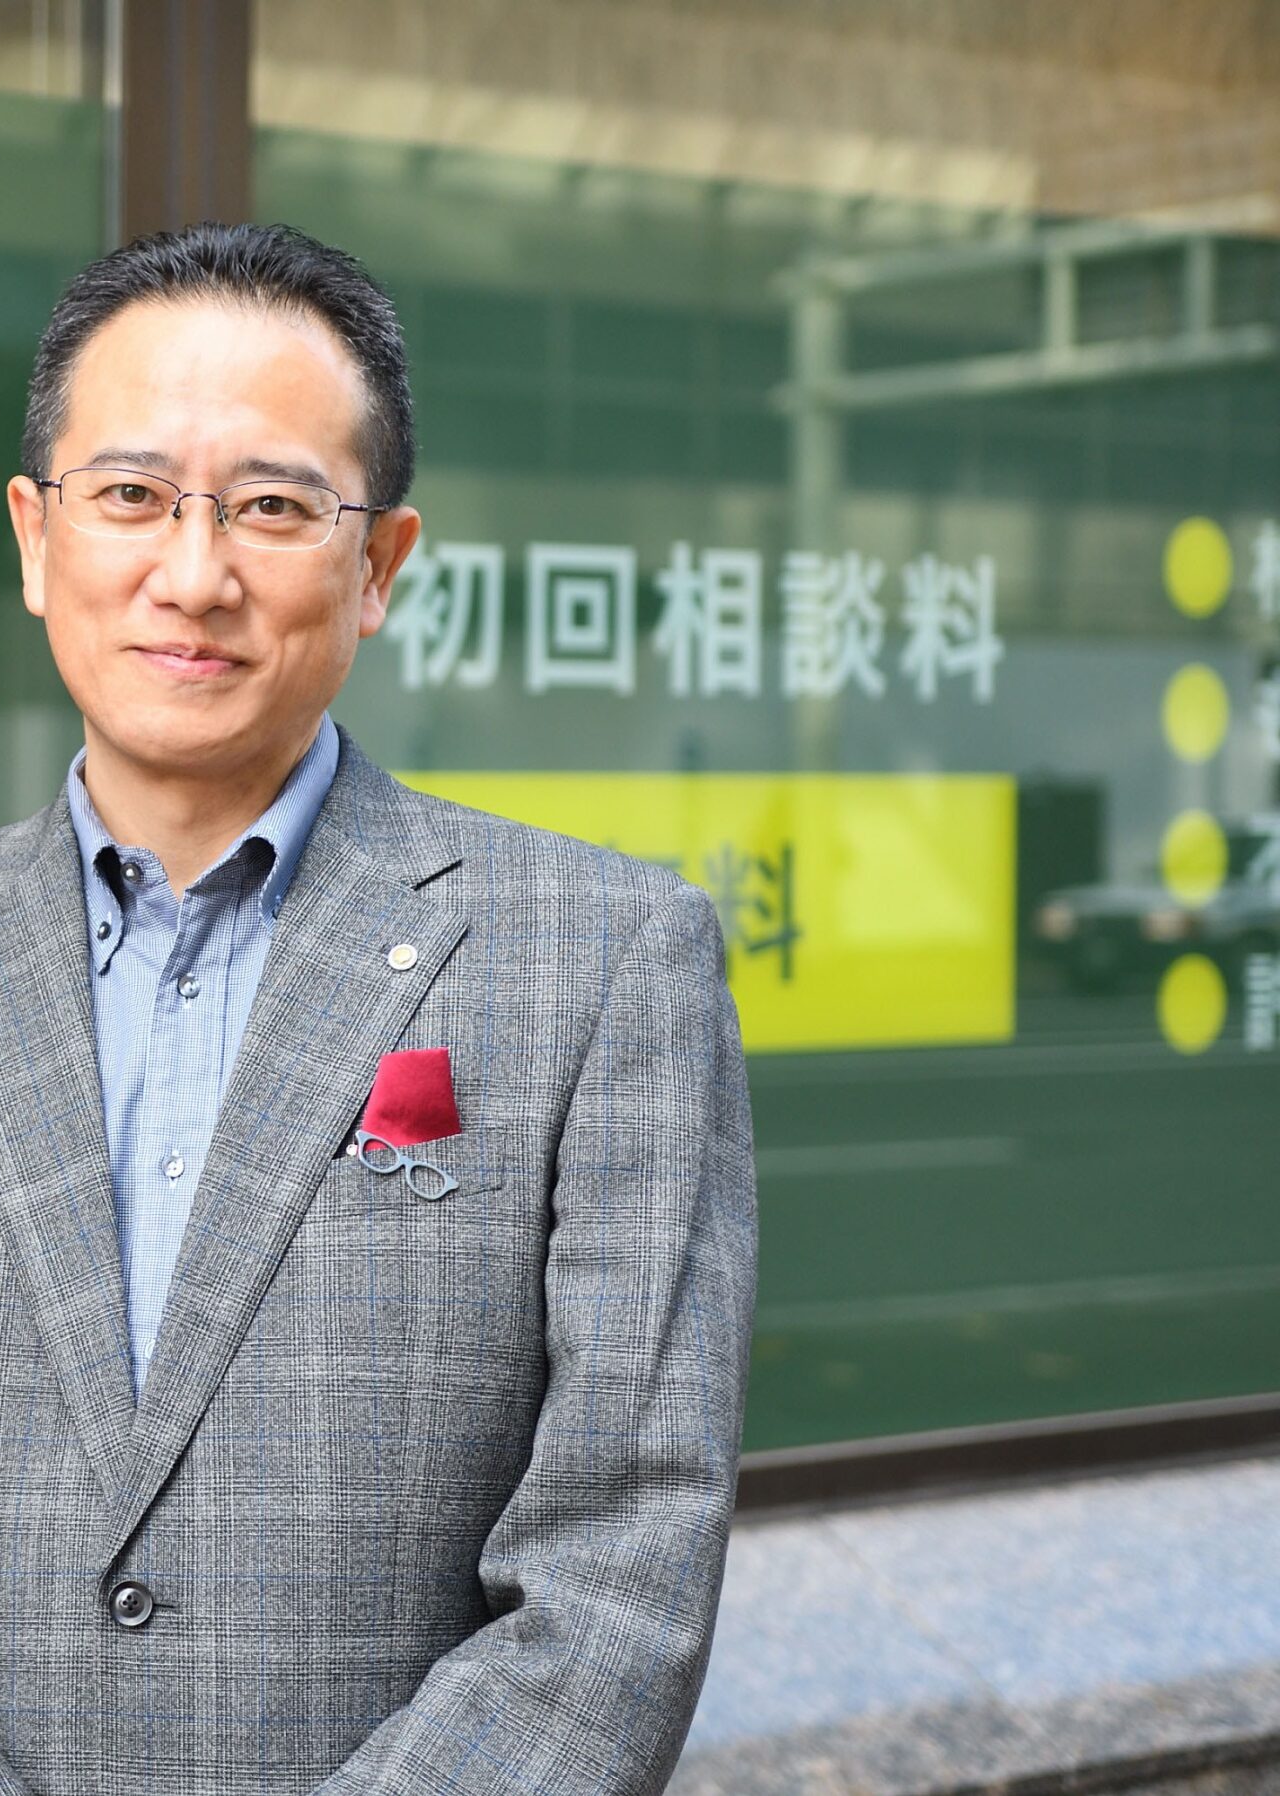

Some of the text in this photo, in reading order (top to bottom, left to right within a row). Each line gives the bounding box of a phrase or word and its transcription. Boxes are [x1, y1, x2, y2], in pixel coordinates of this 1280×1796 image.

[384, 538, 1004, 703] 初回相談料
